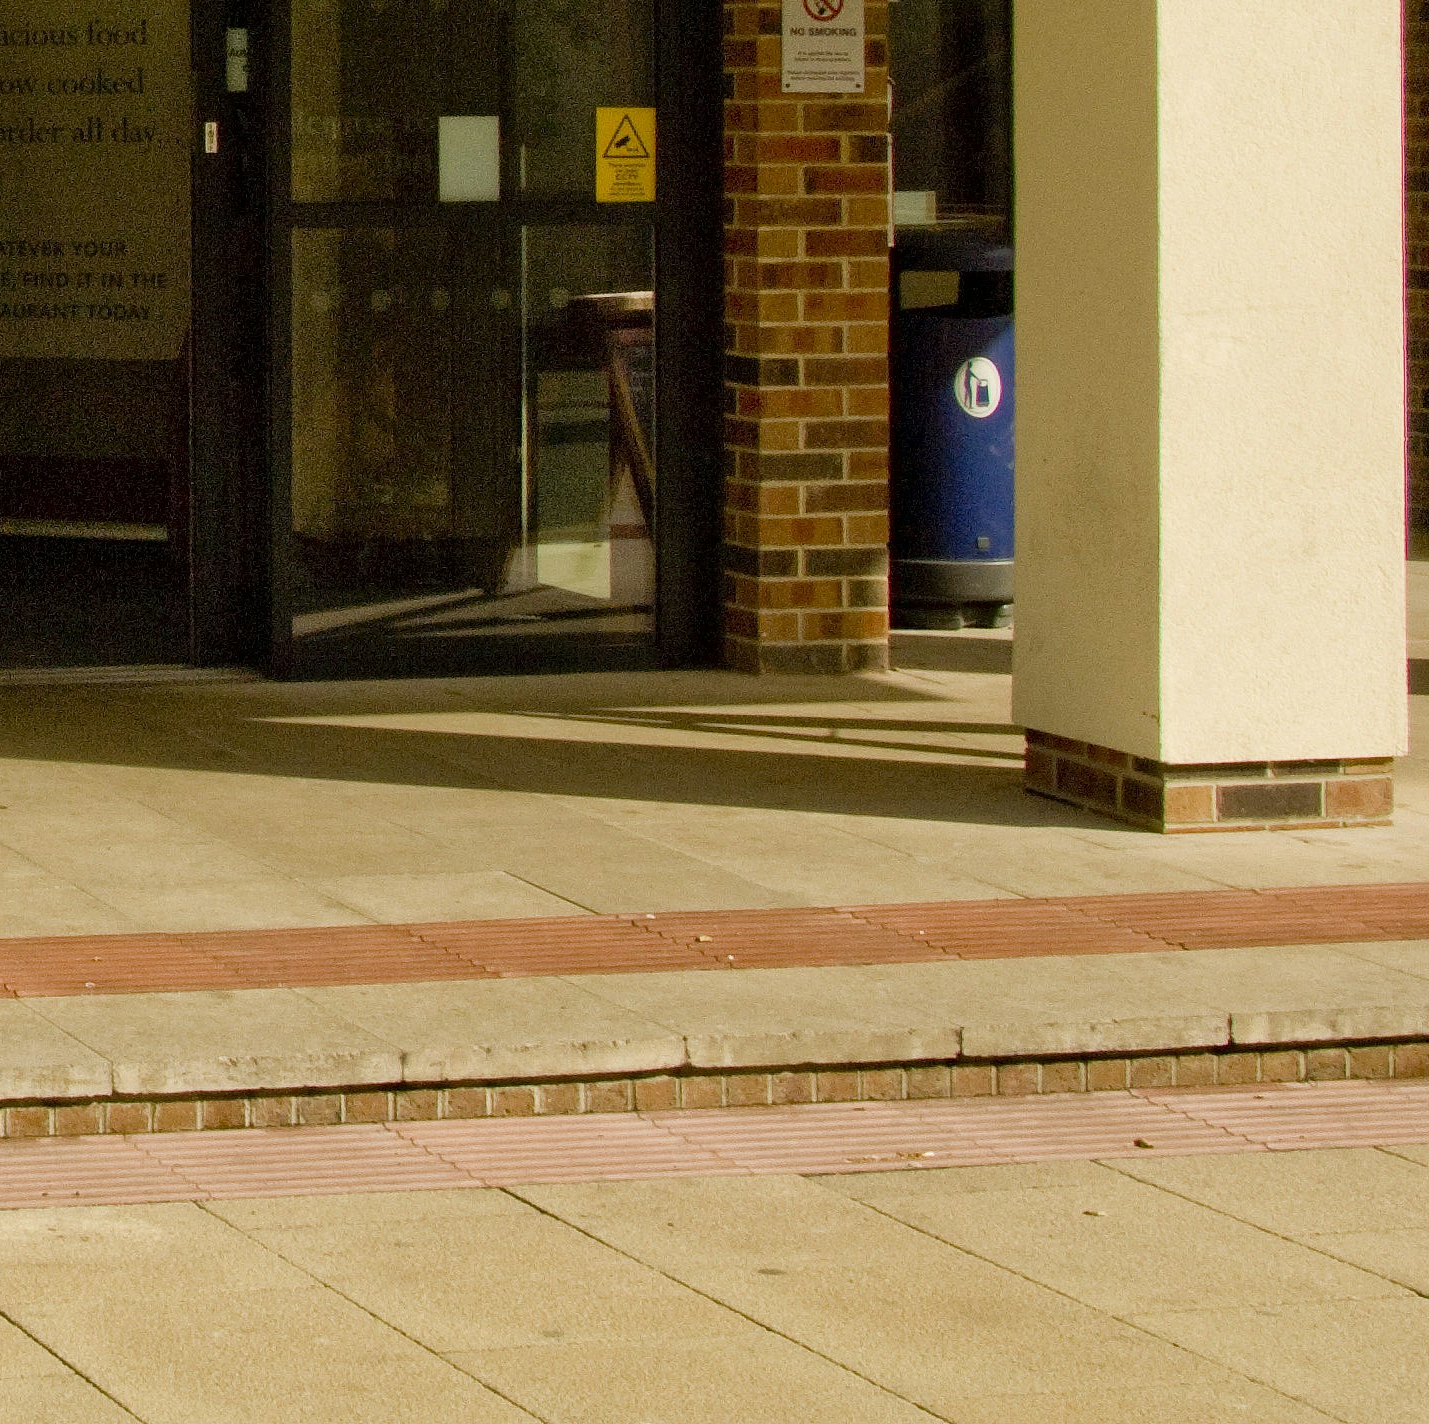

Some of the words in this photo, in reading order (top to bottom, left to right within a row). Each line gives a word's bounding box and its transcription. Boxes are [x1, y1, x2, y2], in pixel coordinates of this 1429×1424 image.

[87, 20, 147, 46] food
[790, 28, 805, 36] NO
[808, 28, 856, 36] SMOKING
[47, 69, 144, 95] cooked
[73, 117, 102, 143] all
[74, 240, 126, 257] YOUR
[23, 272, 69, 288] FIND
[102, 272, 123, 288] IN
[132, 272, 167, 288] THE
